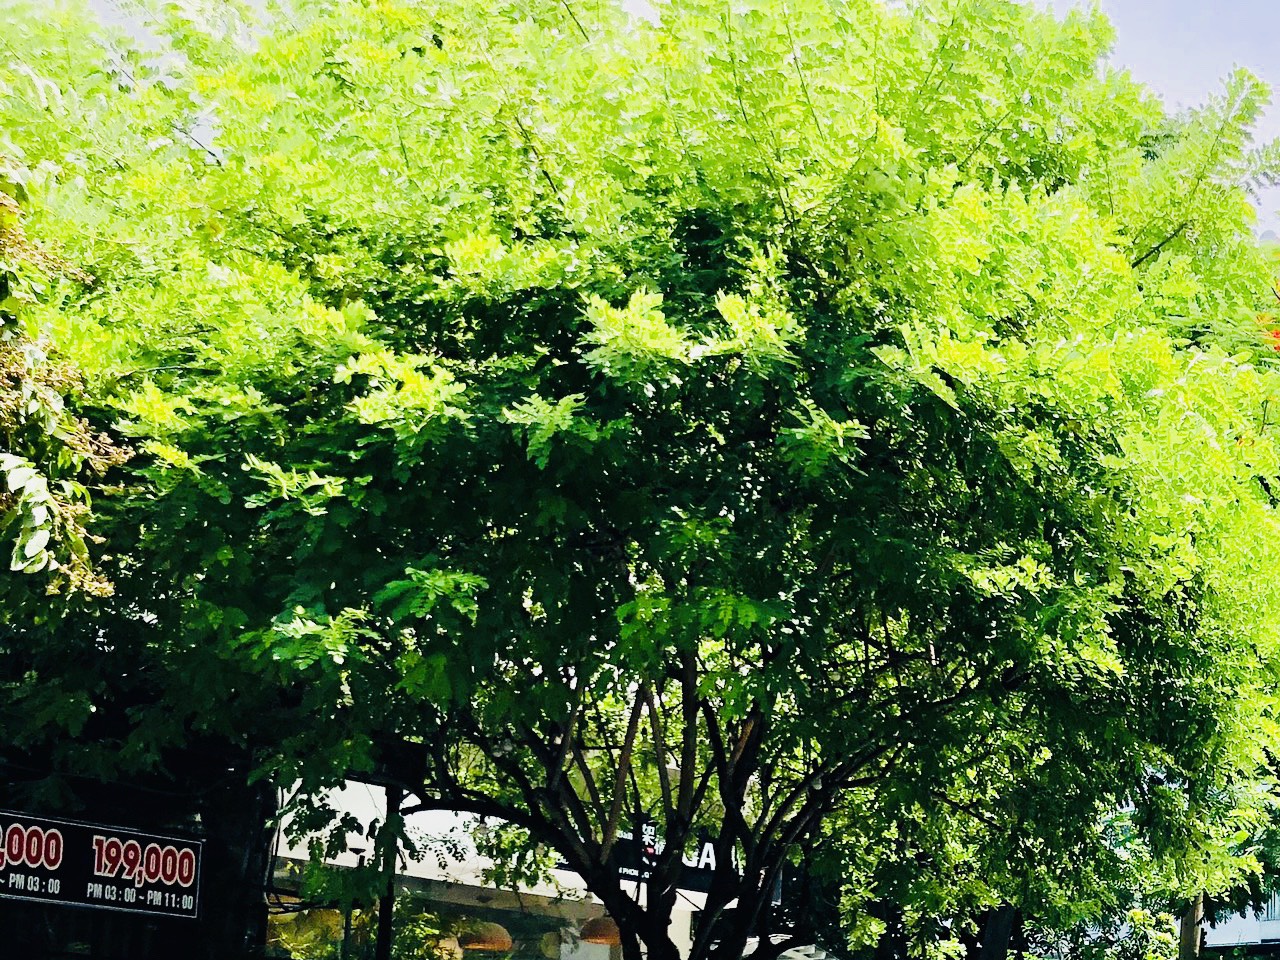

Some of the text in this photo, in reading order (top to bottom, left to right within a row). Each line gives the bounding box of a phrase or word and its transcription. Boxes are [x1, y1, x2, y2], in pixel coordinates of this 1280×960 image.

[92, 834, 196, 888] 199,000
[9, 873, 25, 889] PM
[87, 883, 102, 898] PM
[147, 890, 161, 905] PM
